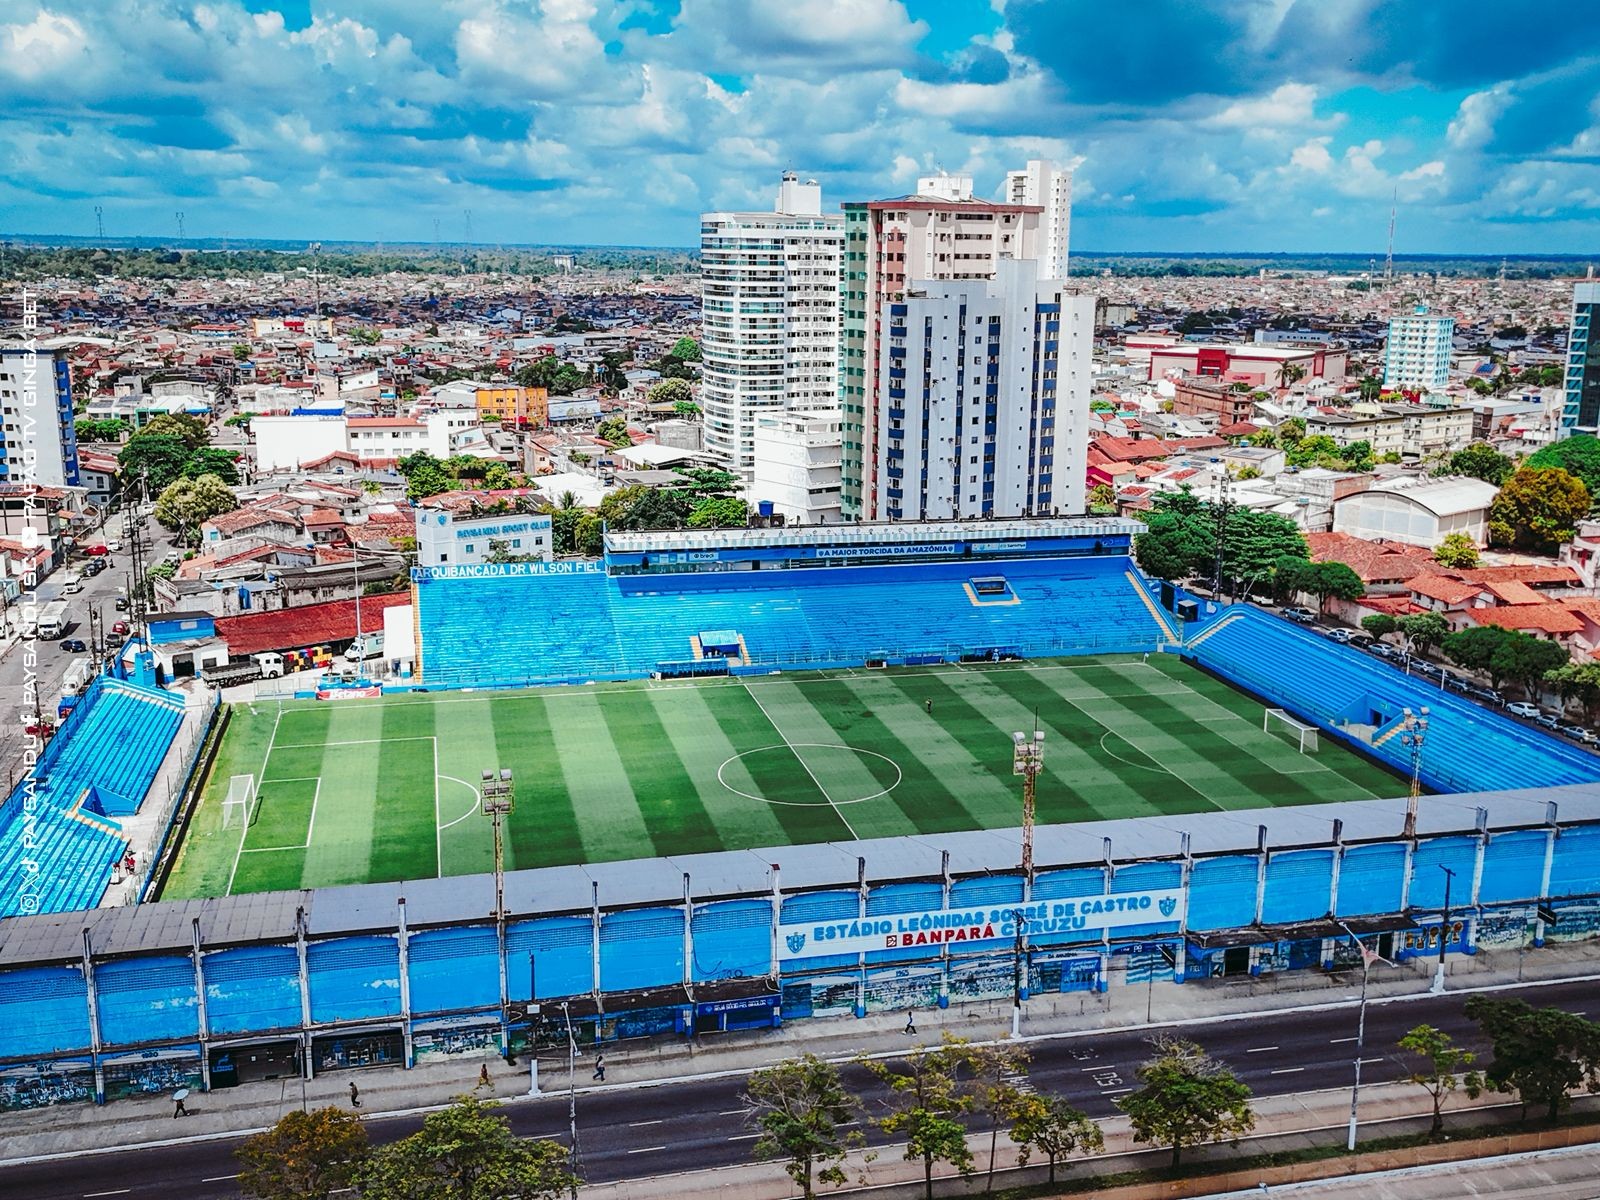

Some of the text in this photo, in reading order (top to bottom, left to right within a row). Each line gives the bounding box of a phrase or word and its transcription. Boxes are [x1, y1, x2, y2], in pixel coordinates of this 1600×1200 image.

[824, 549, 831, 557] A
[832, 548, 858, 556] MAIOR
[859, 547, 892, 556] TORCIDA
[906, 545, 948, 553] AMAZÔNIA
[415, 565, 506, 579] ARQUIBANCADA
[528, 563, 573, 575] WILSON
[575, 562, 600, 573] FIEL
[813, 920, 893, 941] ESTÁDIO
[898, 911, 985, 933] LEÔNIDAS
[1053, 903, 1075, 918] DE
[1080, 896, 1152, 914] CASTRO
[902, 923, 994, 946] BANPARÁ
